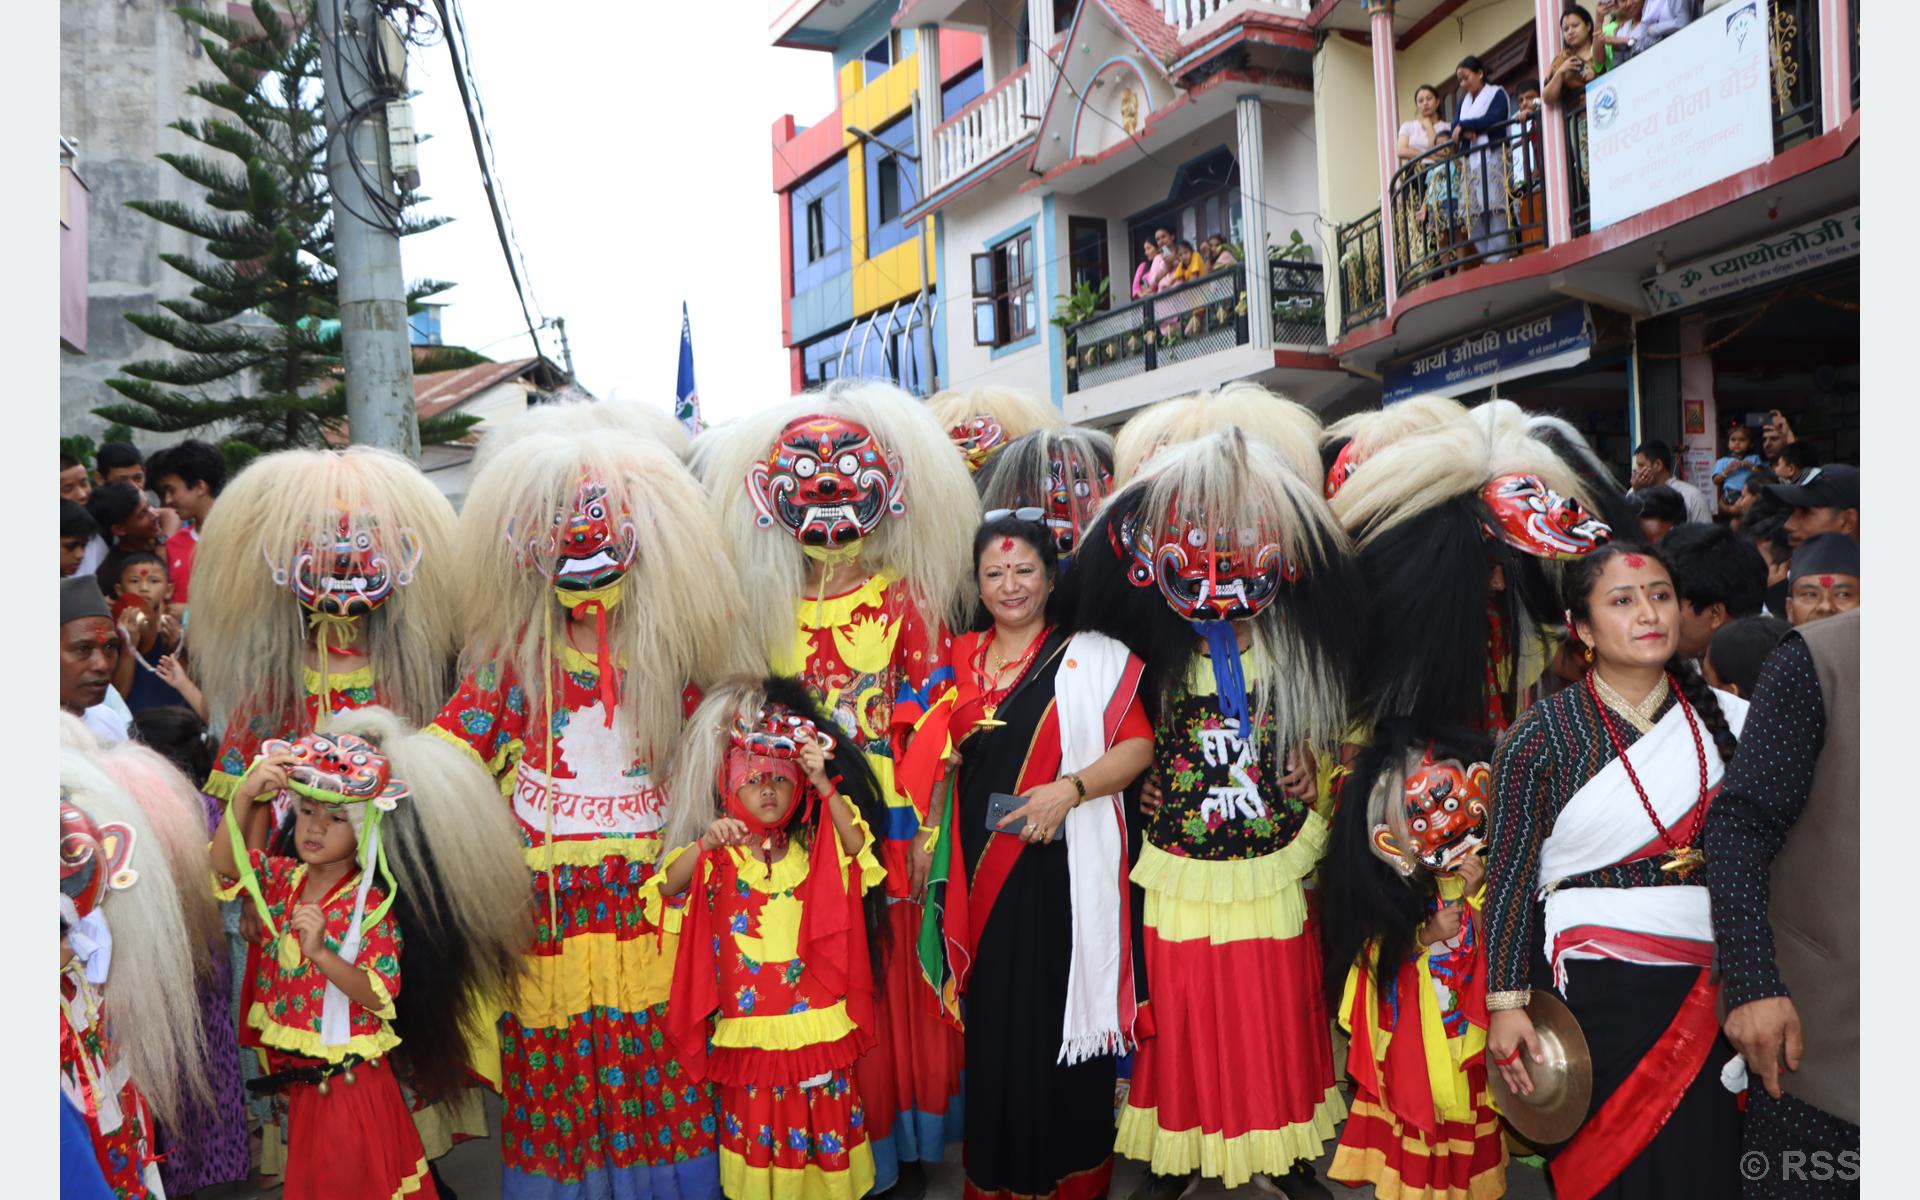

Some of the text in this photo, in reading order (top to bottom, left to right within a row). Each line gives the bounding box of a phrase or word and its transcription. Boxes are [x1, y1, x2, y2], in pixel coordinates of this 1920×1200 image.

[1665, 83, 1711, 128] बीमा
[1680, 268, 1702, 289] ॐ
[1710, 218, 1845, 277] प्याथोलोजी
[1412, 351, 1447, 377] आर्या
[1452, 330, 1500, 364] औषधि
[1506, 315, 1552, 344] पसल
